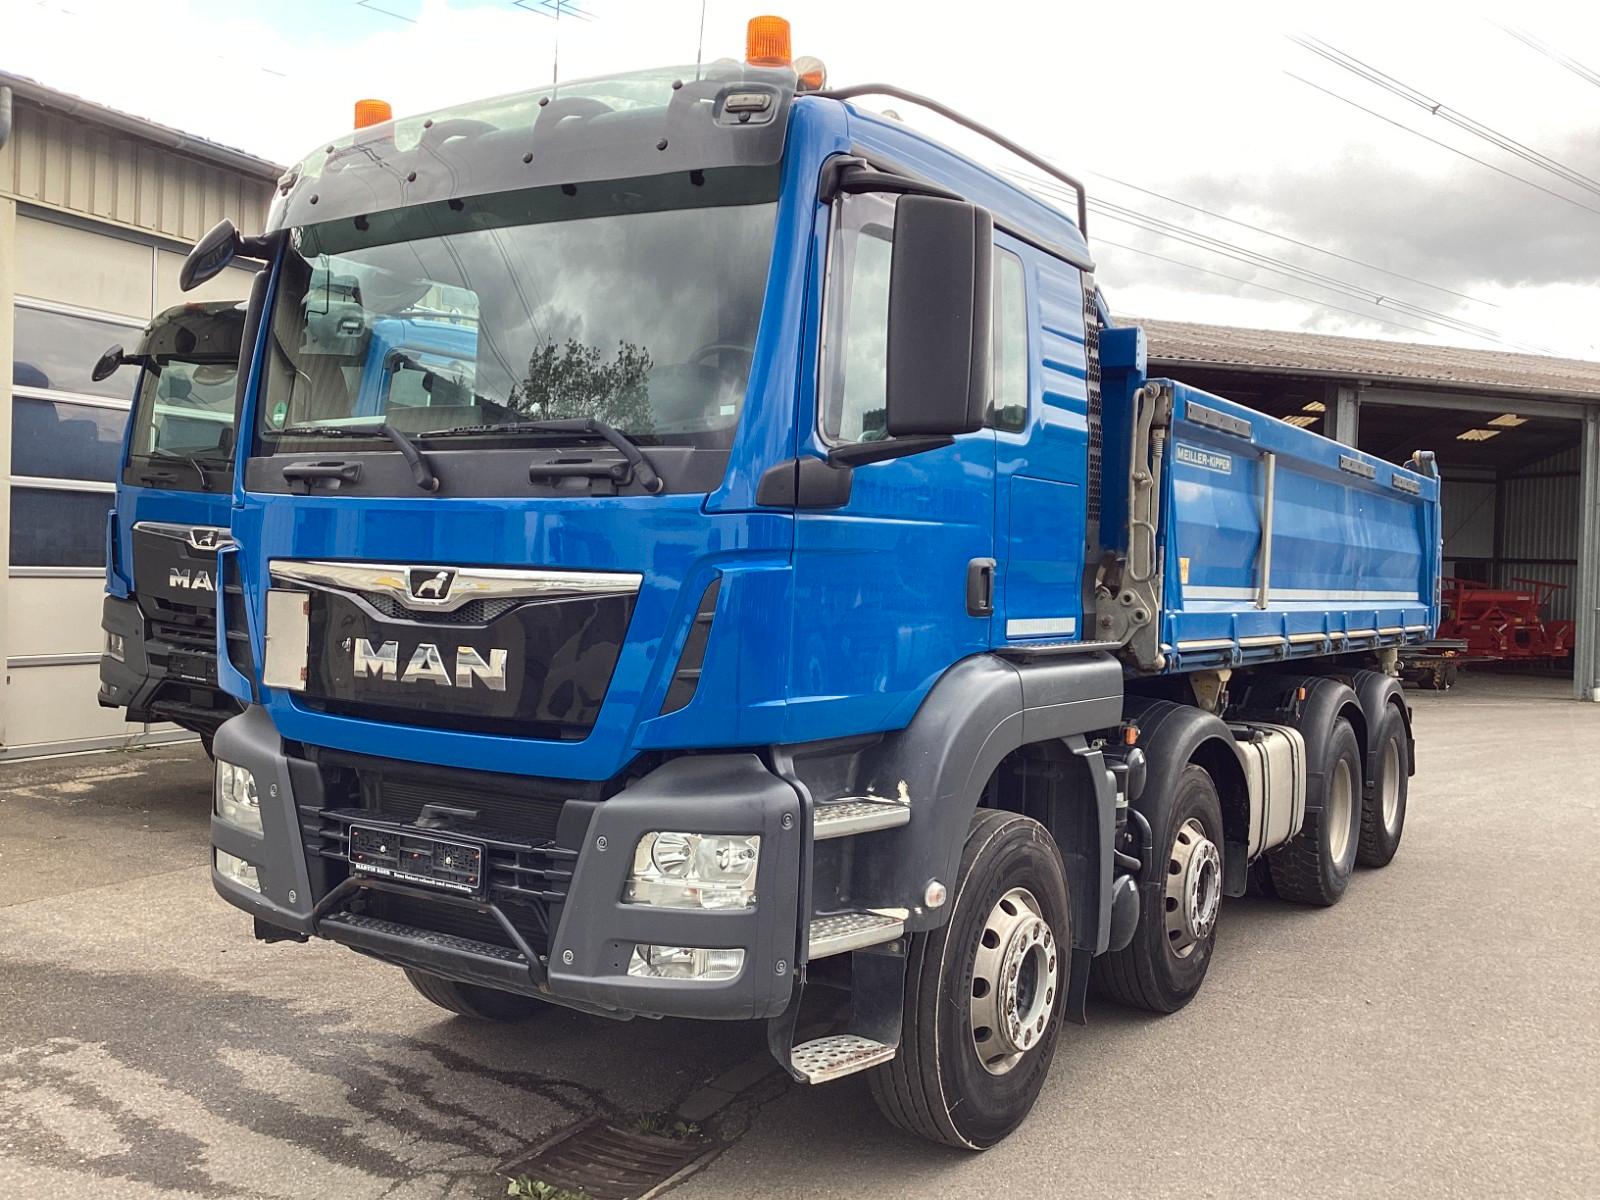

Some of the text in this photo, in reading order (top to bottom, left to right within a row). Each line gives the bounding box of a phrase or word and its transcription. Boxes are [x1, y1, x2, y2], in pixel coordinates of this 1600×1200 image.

[1176, 447, 1230, 471] MEILLER-KIPPER
[169, 567, 217, 591] MA
[353, 638, 508, 691] MAN
